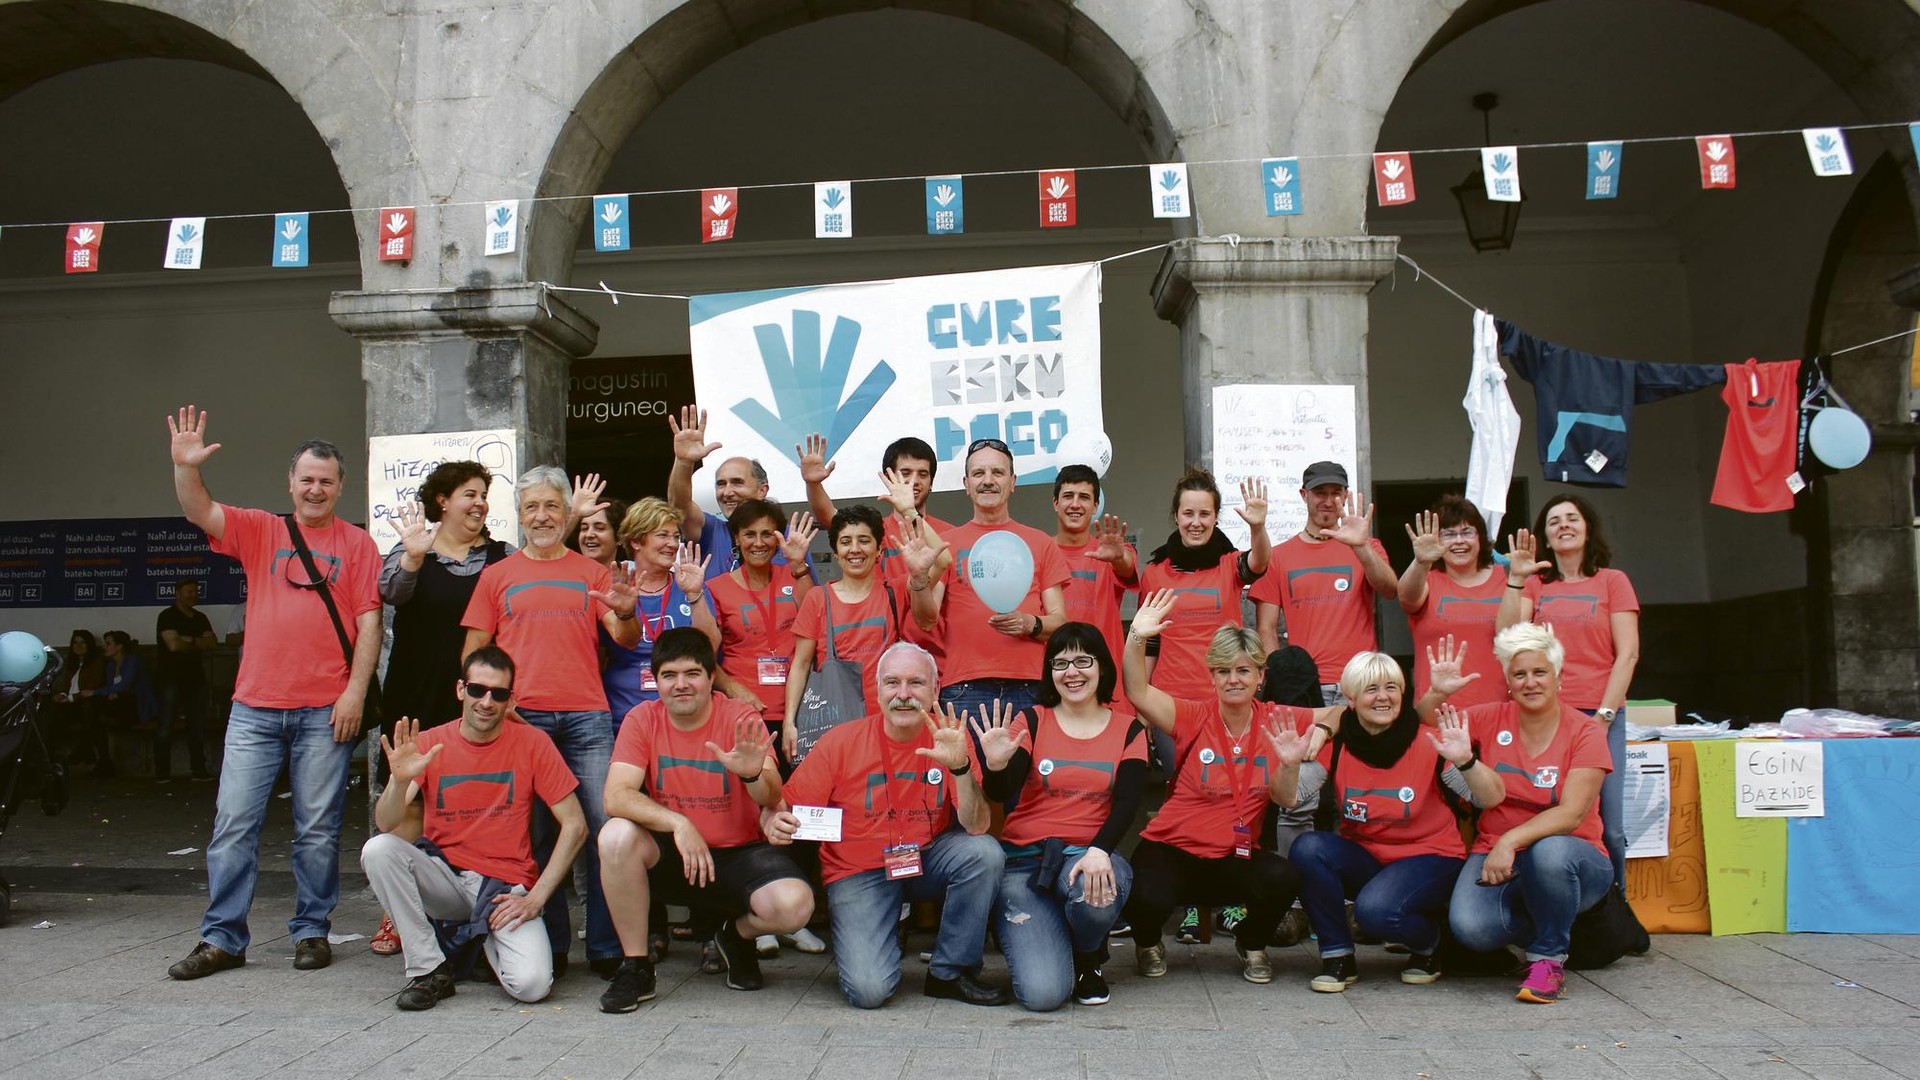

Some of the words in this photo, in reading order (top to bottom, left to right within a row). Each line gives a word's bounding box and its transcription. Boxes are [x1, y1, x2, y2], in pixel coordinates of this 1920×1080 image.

[168, 532, 175, 540] al
[176, 532, 197, 540] duzu
[29, 547, 54, 555] estatu
[84, 546, 109, 554] euskal
[166, 544, 191, 552] euskal
[64, 570, 92, 578] bateko
[94, 568, 128, 576] herritar?
[146, 568, 174, 576] bateko
[176, 567, 211, 576] herritar?
[26, 589, 37, 597] EZ
[78, 588, 93, 596] BAI
[108, 588, 119, 596] EZ
[810, 808, 824, 818] E12
